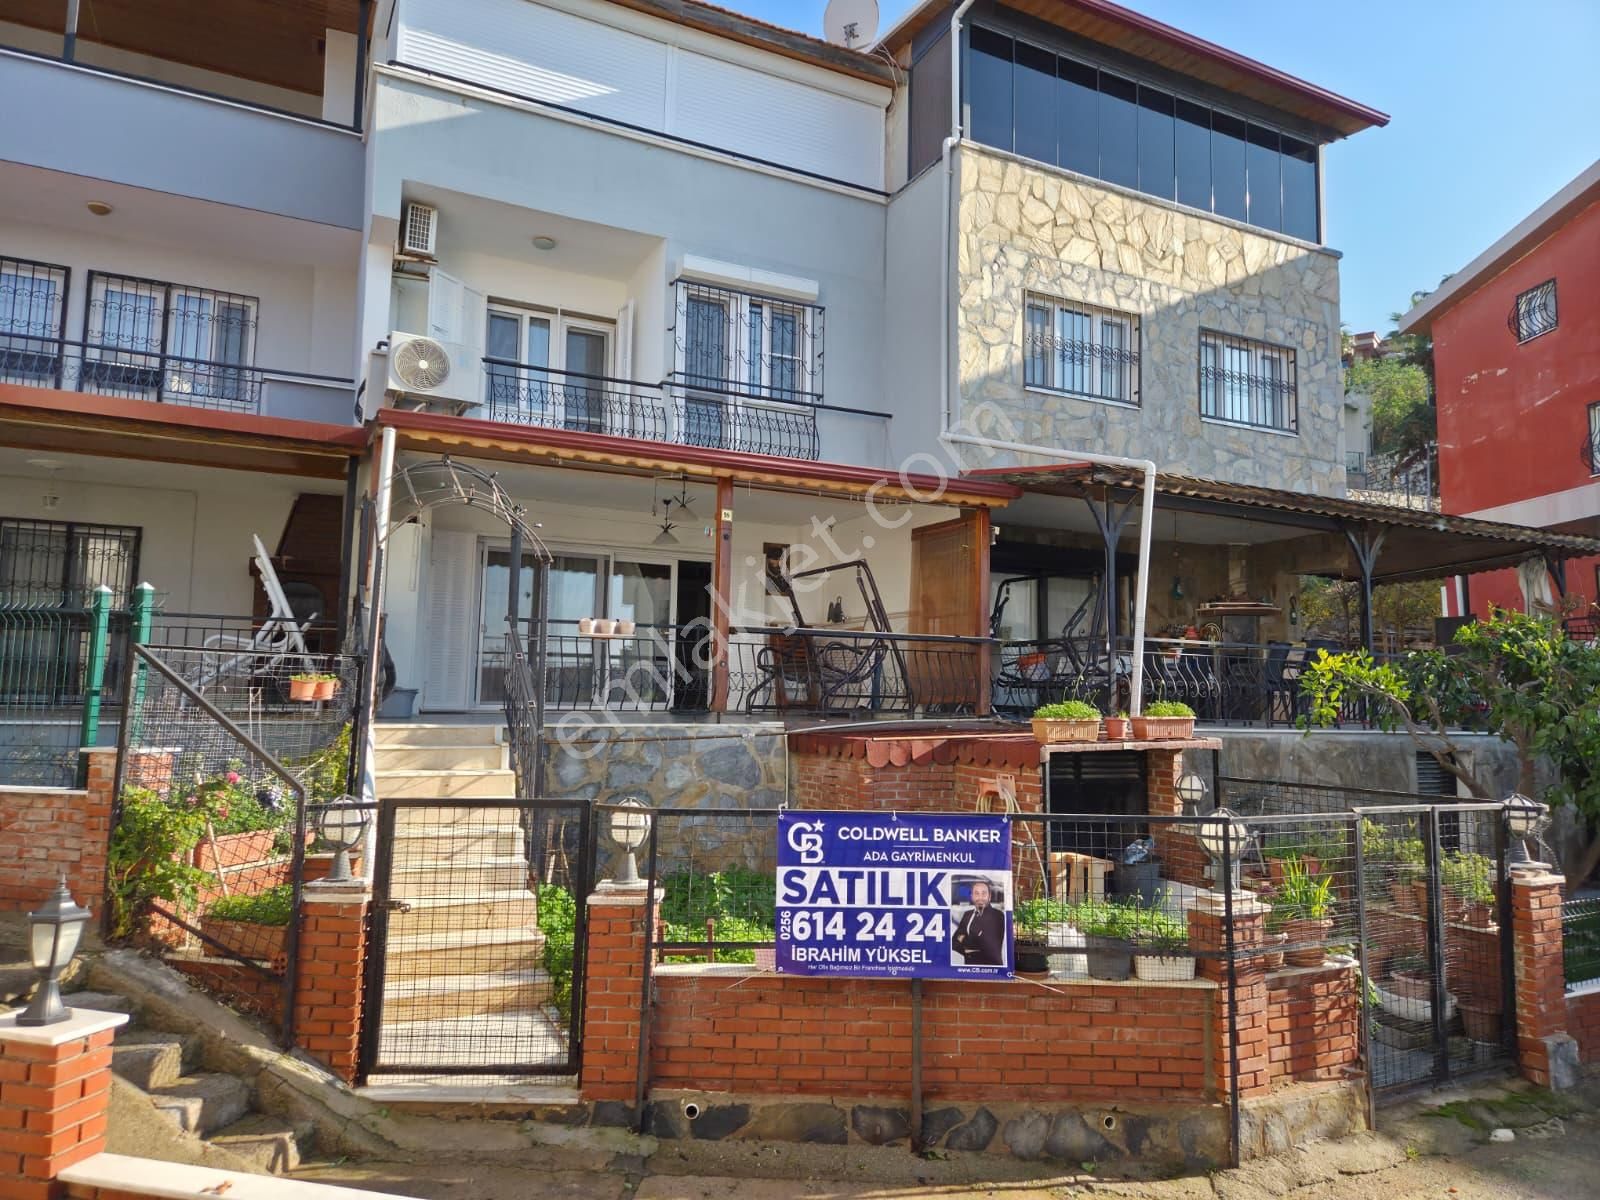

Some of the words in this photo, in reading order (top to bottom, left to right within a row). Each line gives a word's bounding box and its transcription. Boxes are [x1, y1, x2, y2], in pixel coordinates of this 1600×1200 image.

[838, 826, 929, 842] COLDWELL
[933, 829, 1001, 844] BANKER
[863, 851, 889, 862] ADA
[891, 850, 976, 864] GAYRİMENKUL
[782, 869, 948, 907] SATILIK
[780, 910, 791, 940] 0256
[792, 911, 847, 941] 614
[856, 912, 896, 942] 24
[906, 913, 946, 943] 24
[791, 944, 861, 962] İBRAHİM
[865, 946, 932, 964] YÜKSEL
